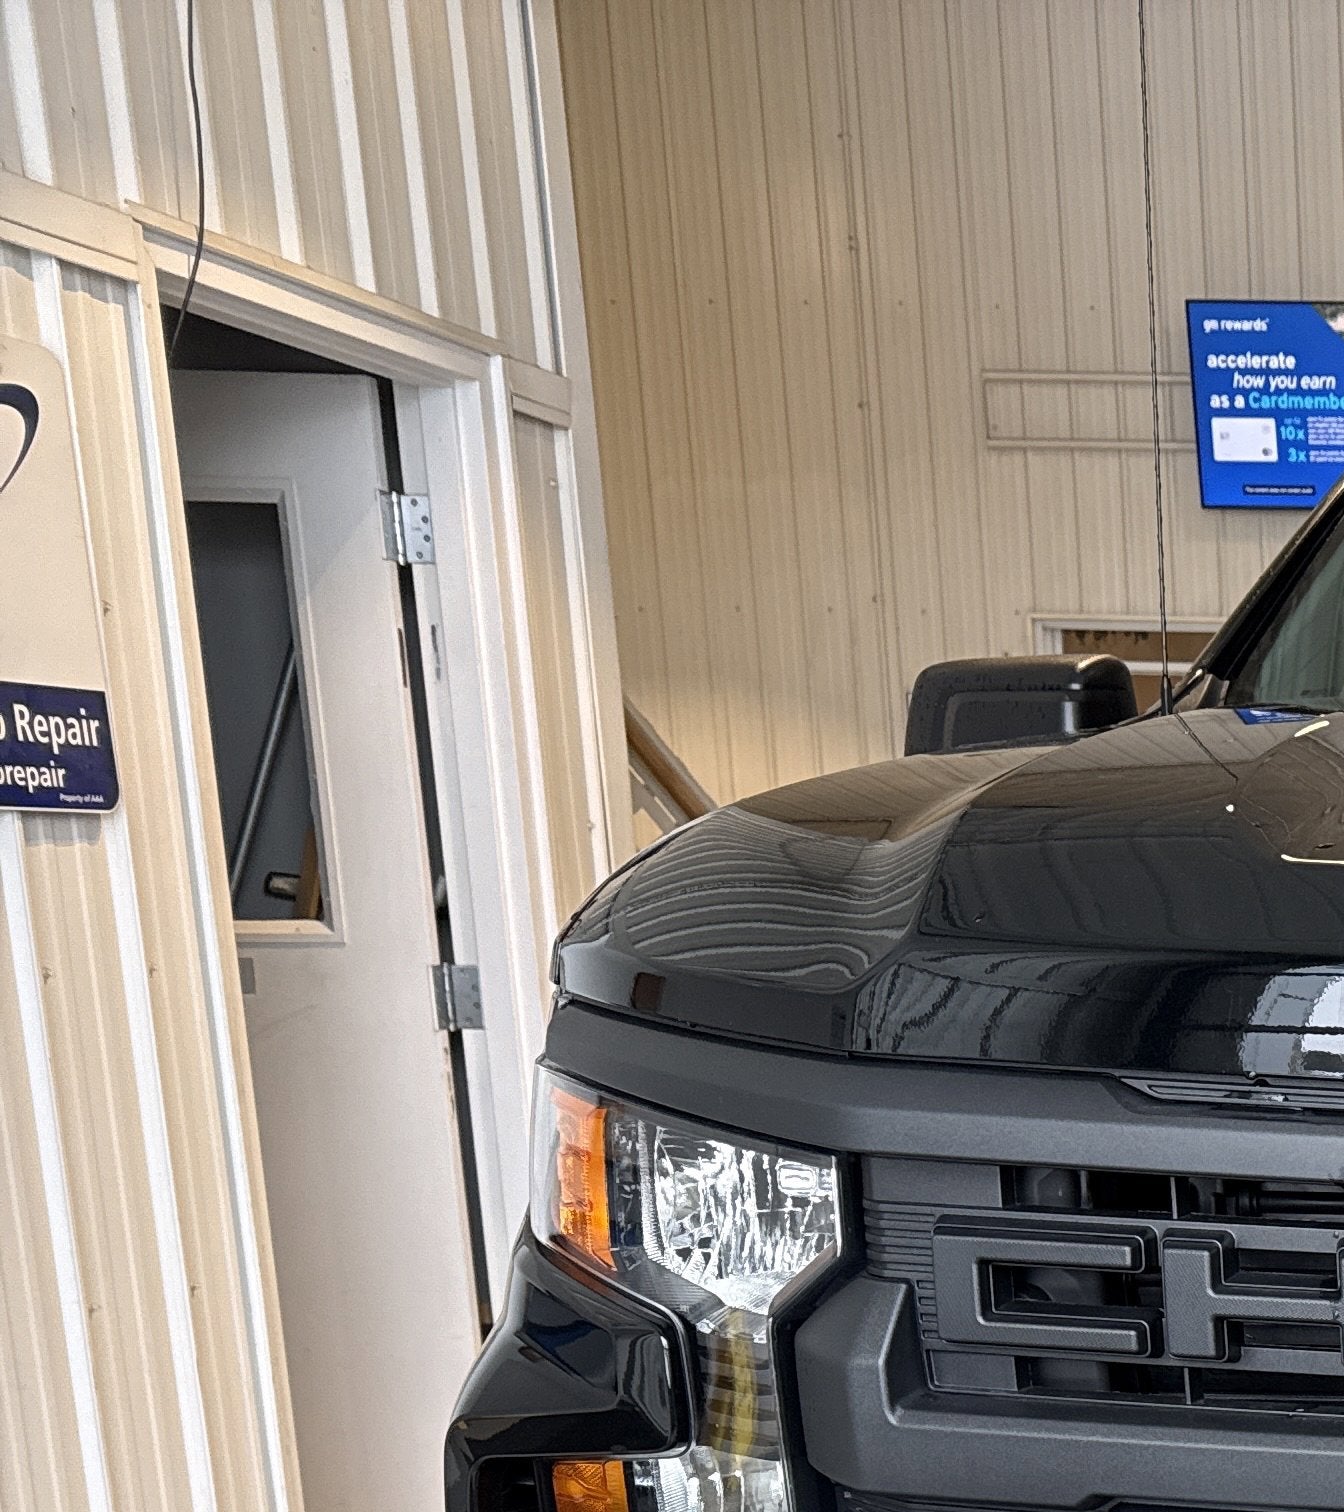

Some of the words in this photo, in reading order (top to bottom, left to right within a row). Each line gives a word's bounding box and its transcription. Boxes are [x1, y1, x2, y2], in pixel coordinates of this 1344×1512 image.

[1220, 318, 1268, 332] rewards
[1207, 351, 1296, 369] accelerate
[1233, 371, 1265, 389] how
[1269, 375, 1297, 393] you
[1300, 375, 1336, 390] earn
[1210, 394, 1230, 409] as
[1234, 394, 1245, 409] a
[13, 703, 100, 755] Repair
